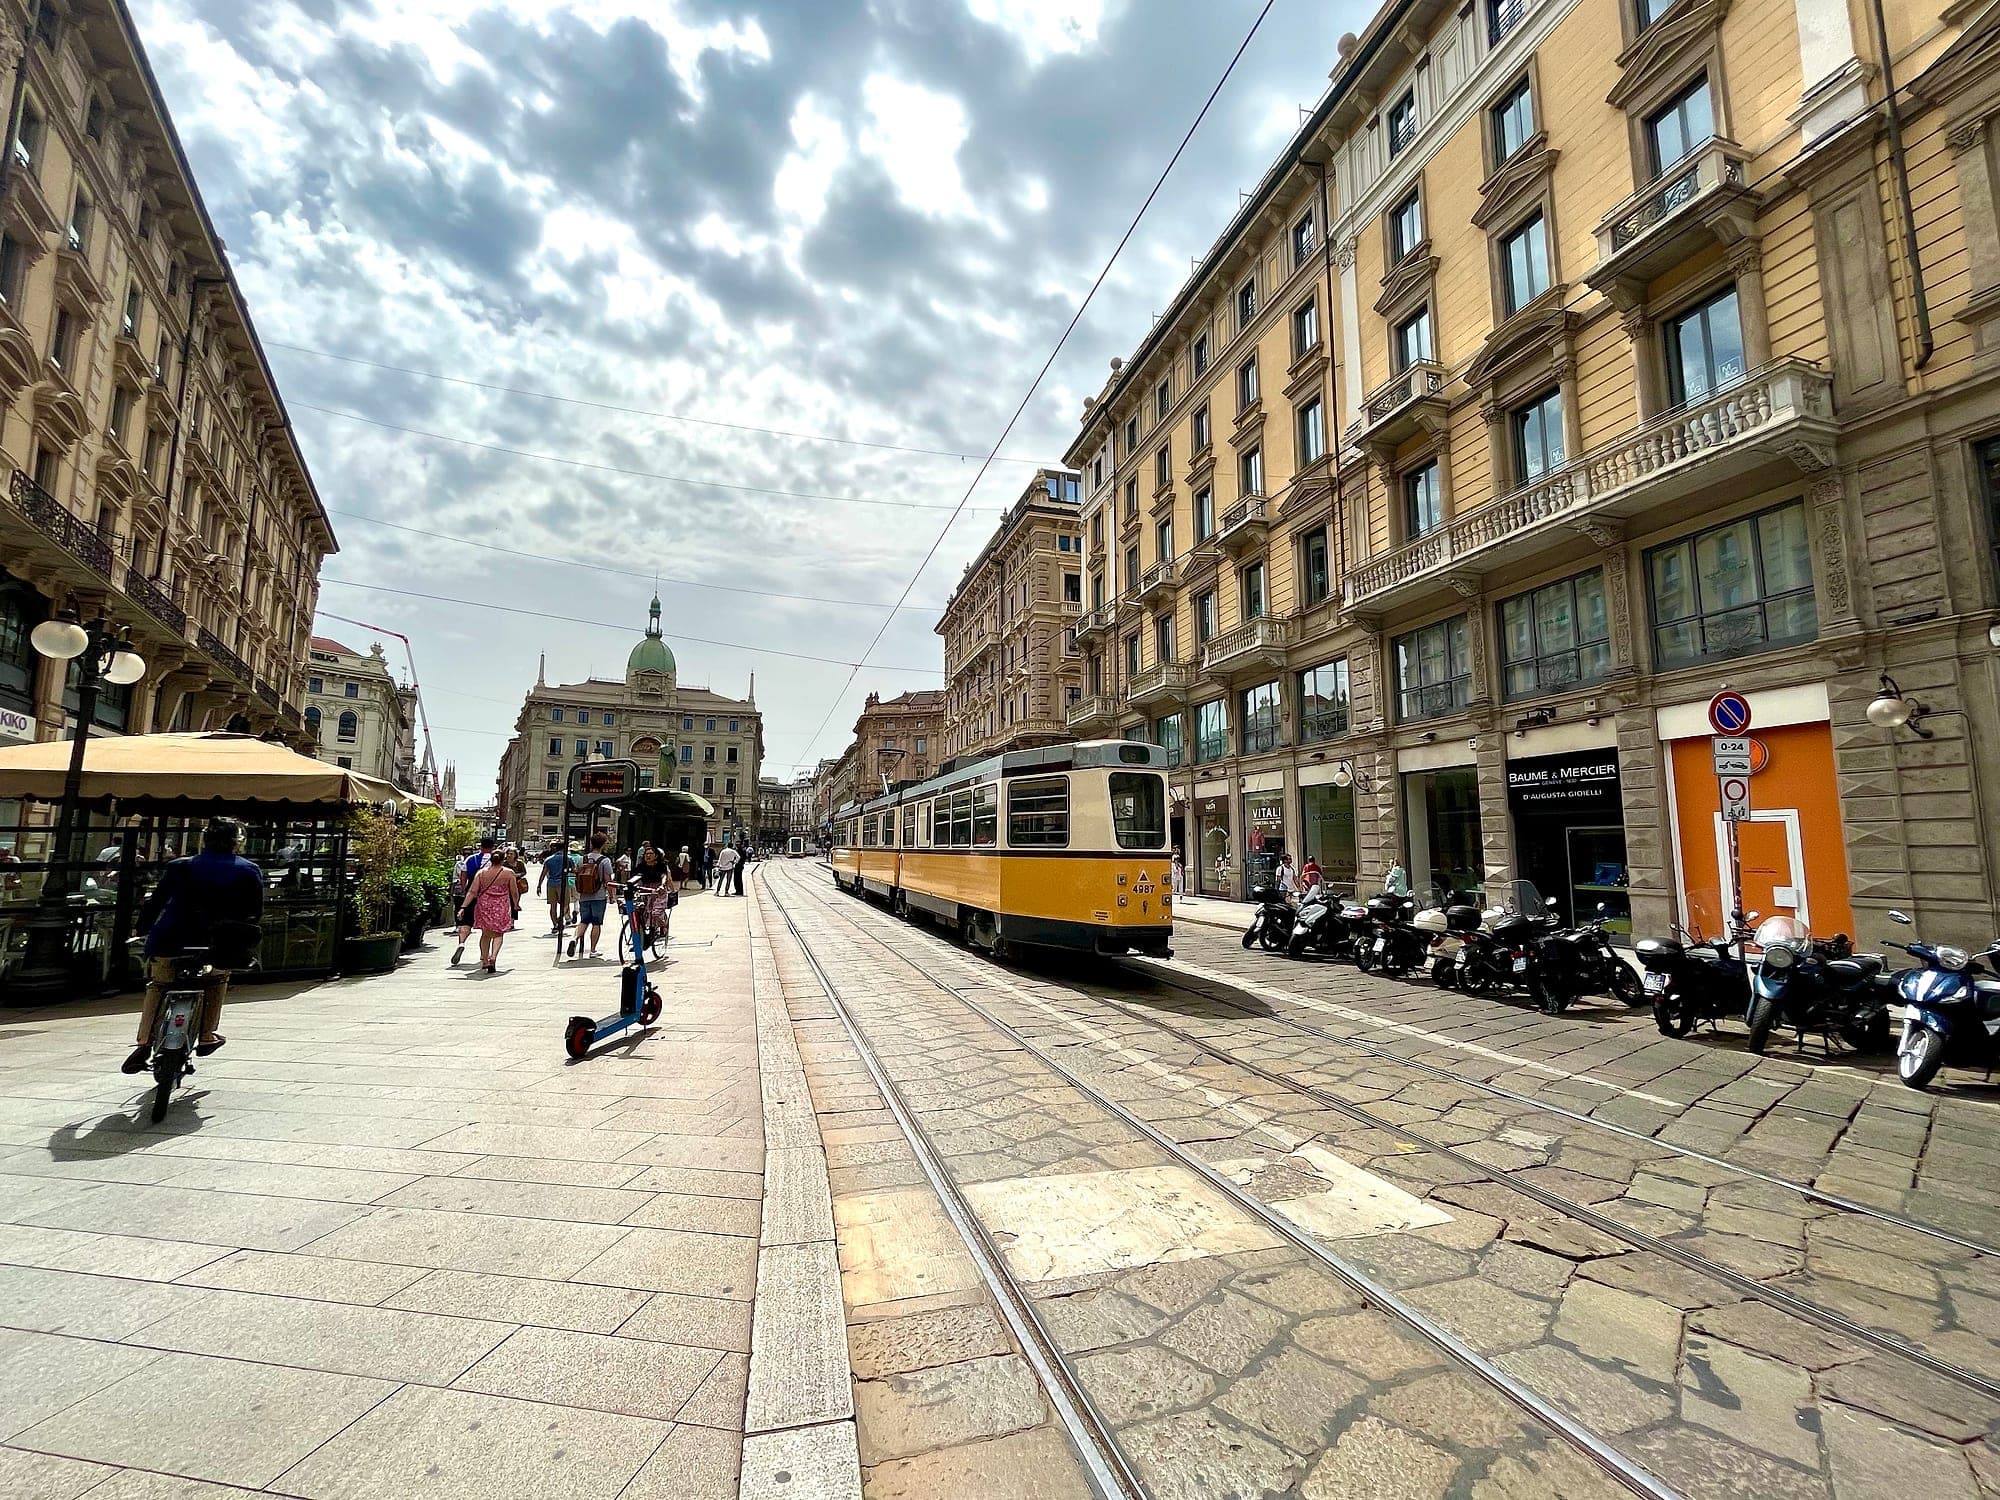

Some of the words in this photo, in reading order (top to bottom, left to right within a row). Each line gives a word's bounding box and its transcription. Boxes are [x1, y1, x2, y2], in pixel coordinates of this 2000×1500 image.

[0, 711, 27, 730] KIKO
[1720, 743, 1744, 751] 0-24
[1508, 771, 1548, 783] BAUME
[1560, 764, 1616, 778] MERCIER
[1522, 791, 1566, 800] D'AUGUSTA
[1568, 789, 1602, 798] GIOIELLI
[1252, 806, 1281, 818] VITALI
[1312, 812, 1342, 822] MARC
[1132, 884, 1155, 894] 4987
